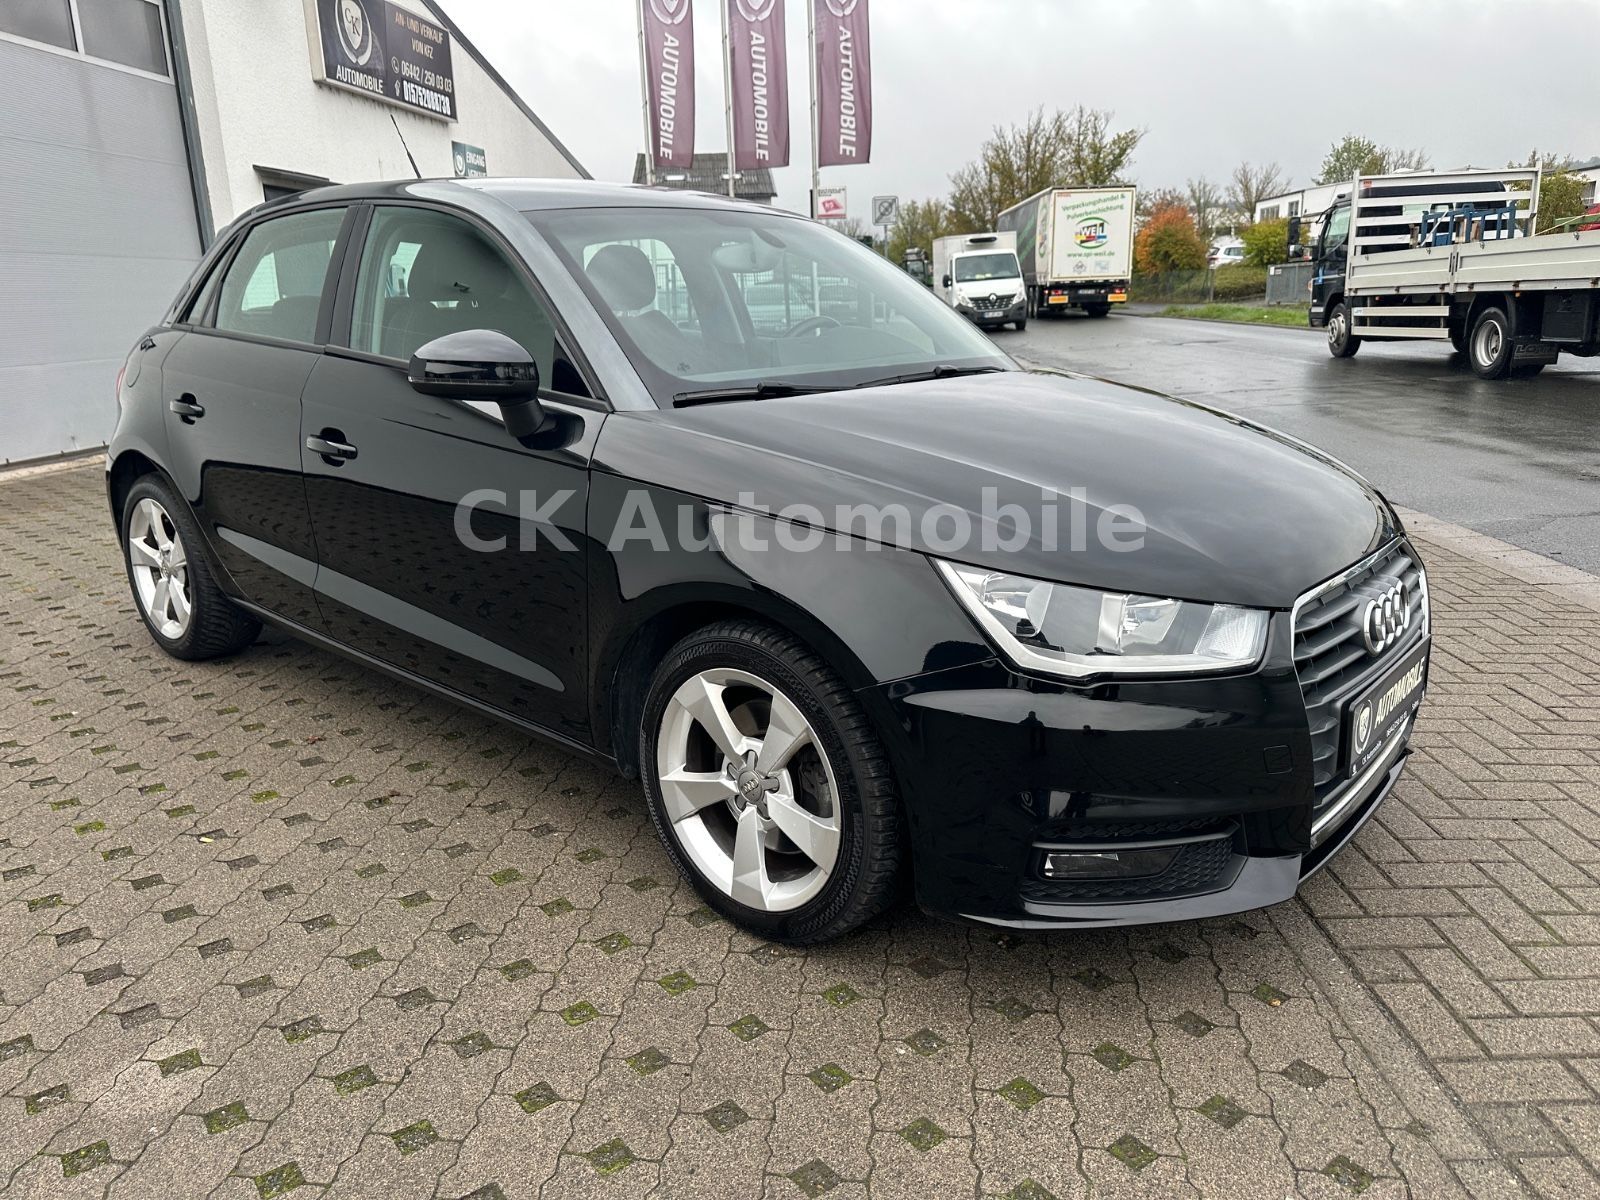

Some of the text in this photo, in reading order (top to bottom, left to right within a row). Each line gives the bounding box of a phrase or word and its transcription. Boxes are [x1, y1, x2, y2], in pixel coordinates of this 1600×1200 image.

[406, 16, 420, 34] UND
[420, 21, 444, 44] VERKAUF
[411, 38, 434, 60] VON KFZ
[336, 64, 384, 94] AUTOMOBILE
[659, 32, 680, 161] AUTOMOBILE
[750, 30, 769, 161] AUTOMOBILE
[839, 25, 857, 158] AUTOMOBILE
[1081, 222, 1106, 236] WEIL
[1374, 656, 1426, 731] AUTOMOBILE
